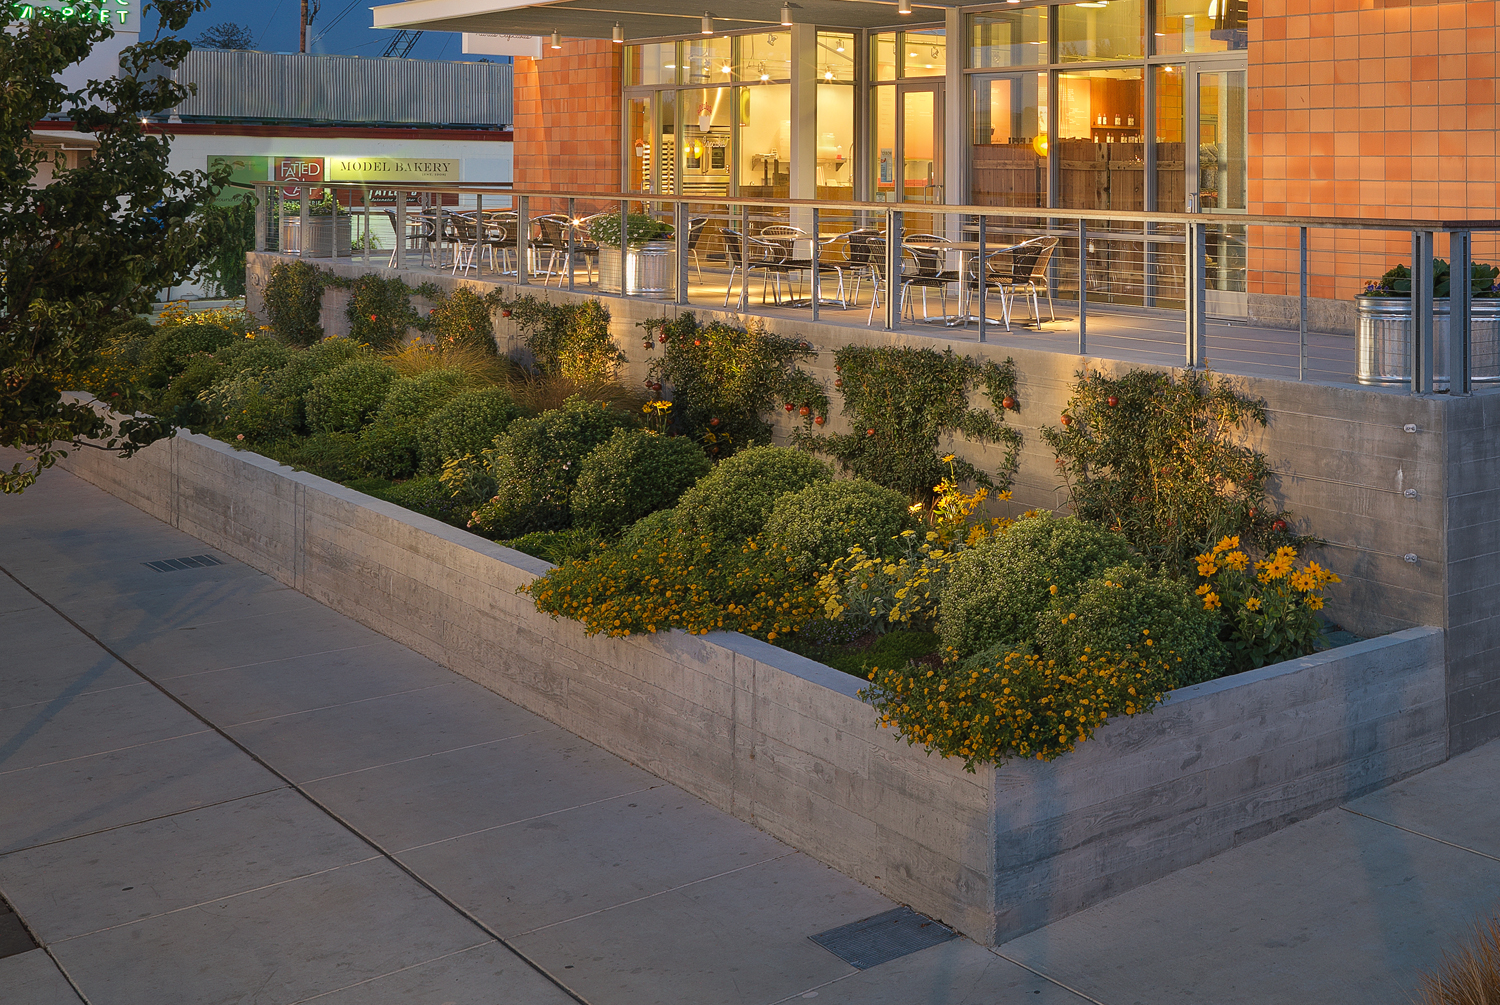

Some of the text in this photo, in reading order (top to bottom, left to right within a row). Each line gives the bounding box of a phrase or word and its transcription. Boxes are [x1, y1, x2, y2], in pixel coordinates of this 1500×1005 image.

[281, 161, 320, 177] FATTED
[340, 161, 451, 173] MODEL BAKERY
